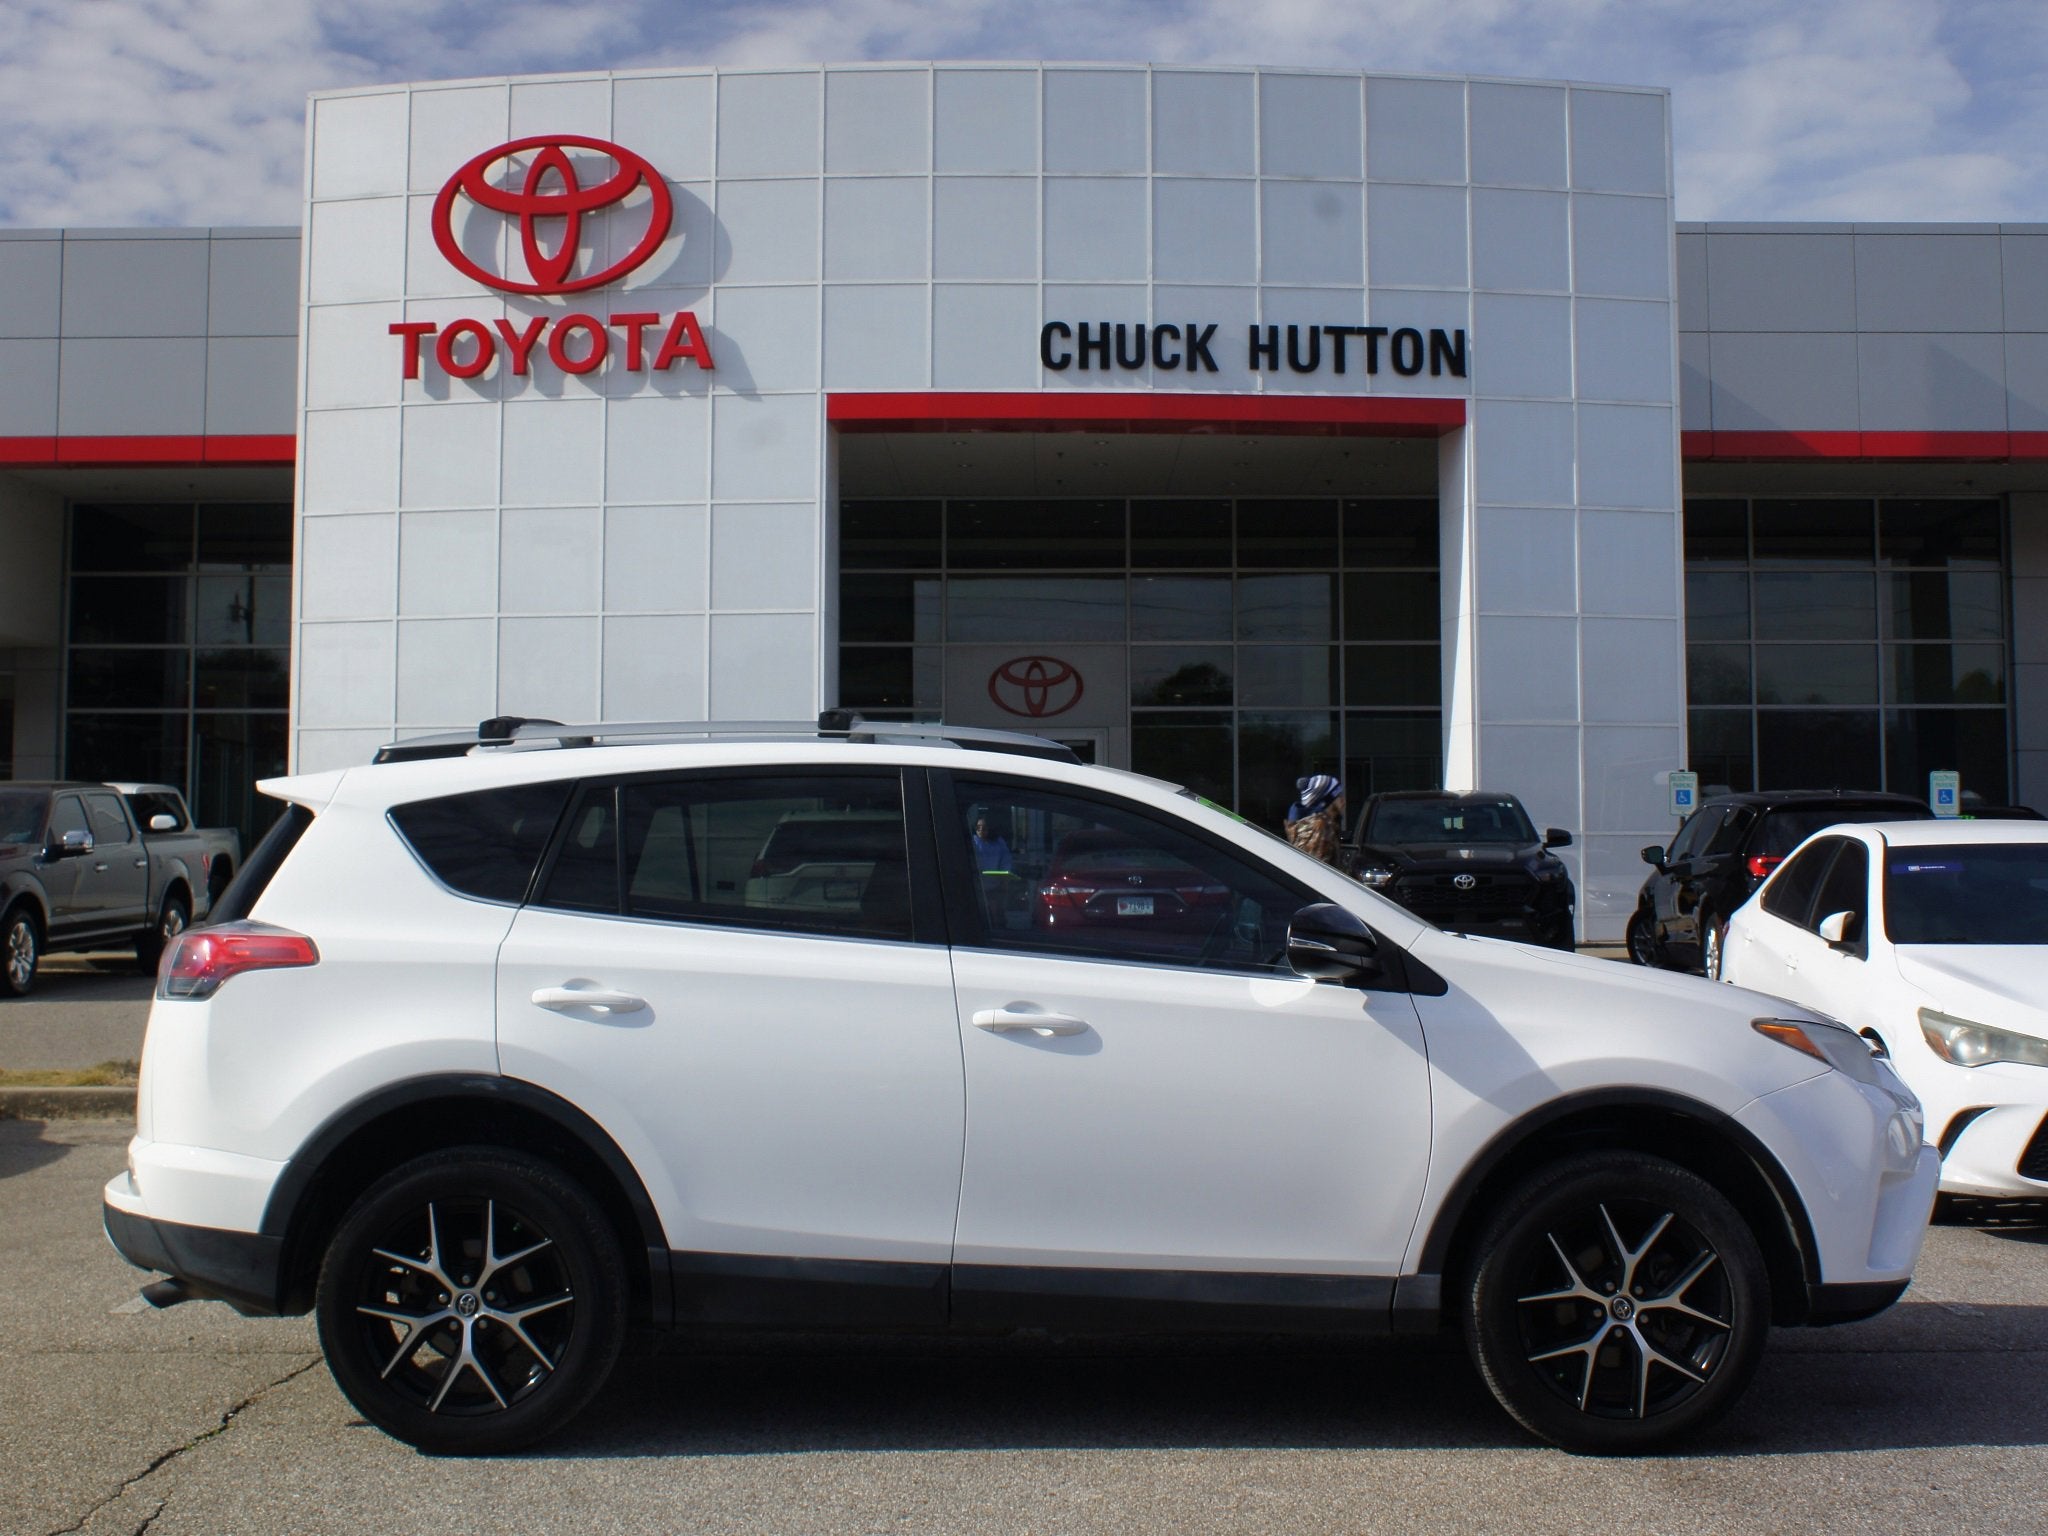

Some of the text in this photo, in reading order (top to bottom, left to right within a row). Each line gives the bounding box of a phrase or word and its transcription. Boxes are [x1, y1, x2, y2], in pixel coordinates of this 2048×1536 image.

[388, 311, 716, 380] TOYOTA
[1040, 321, 1468, 378] CHUCK HUTTON
